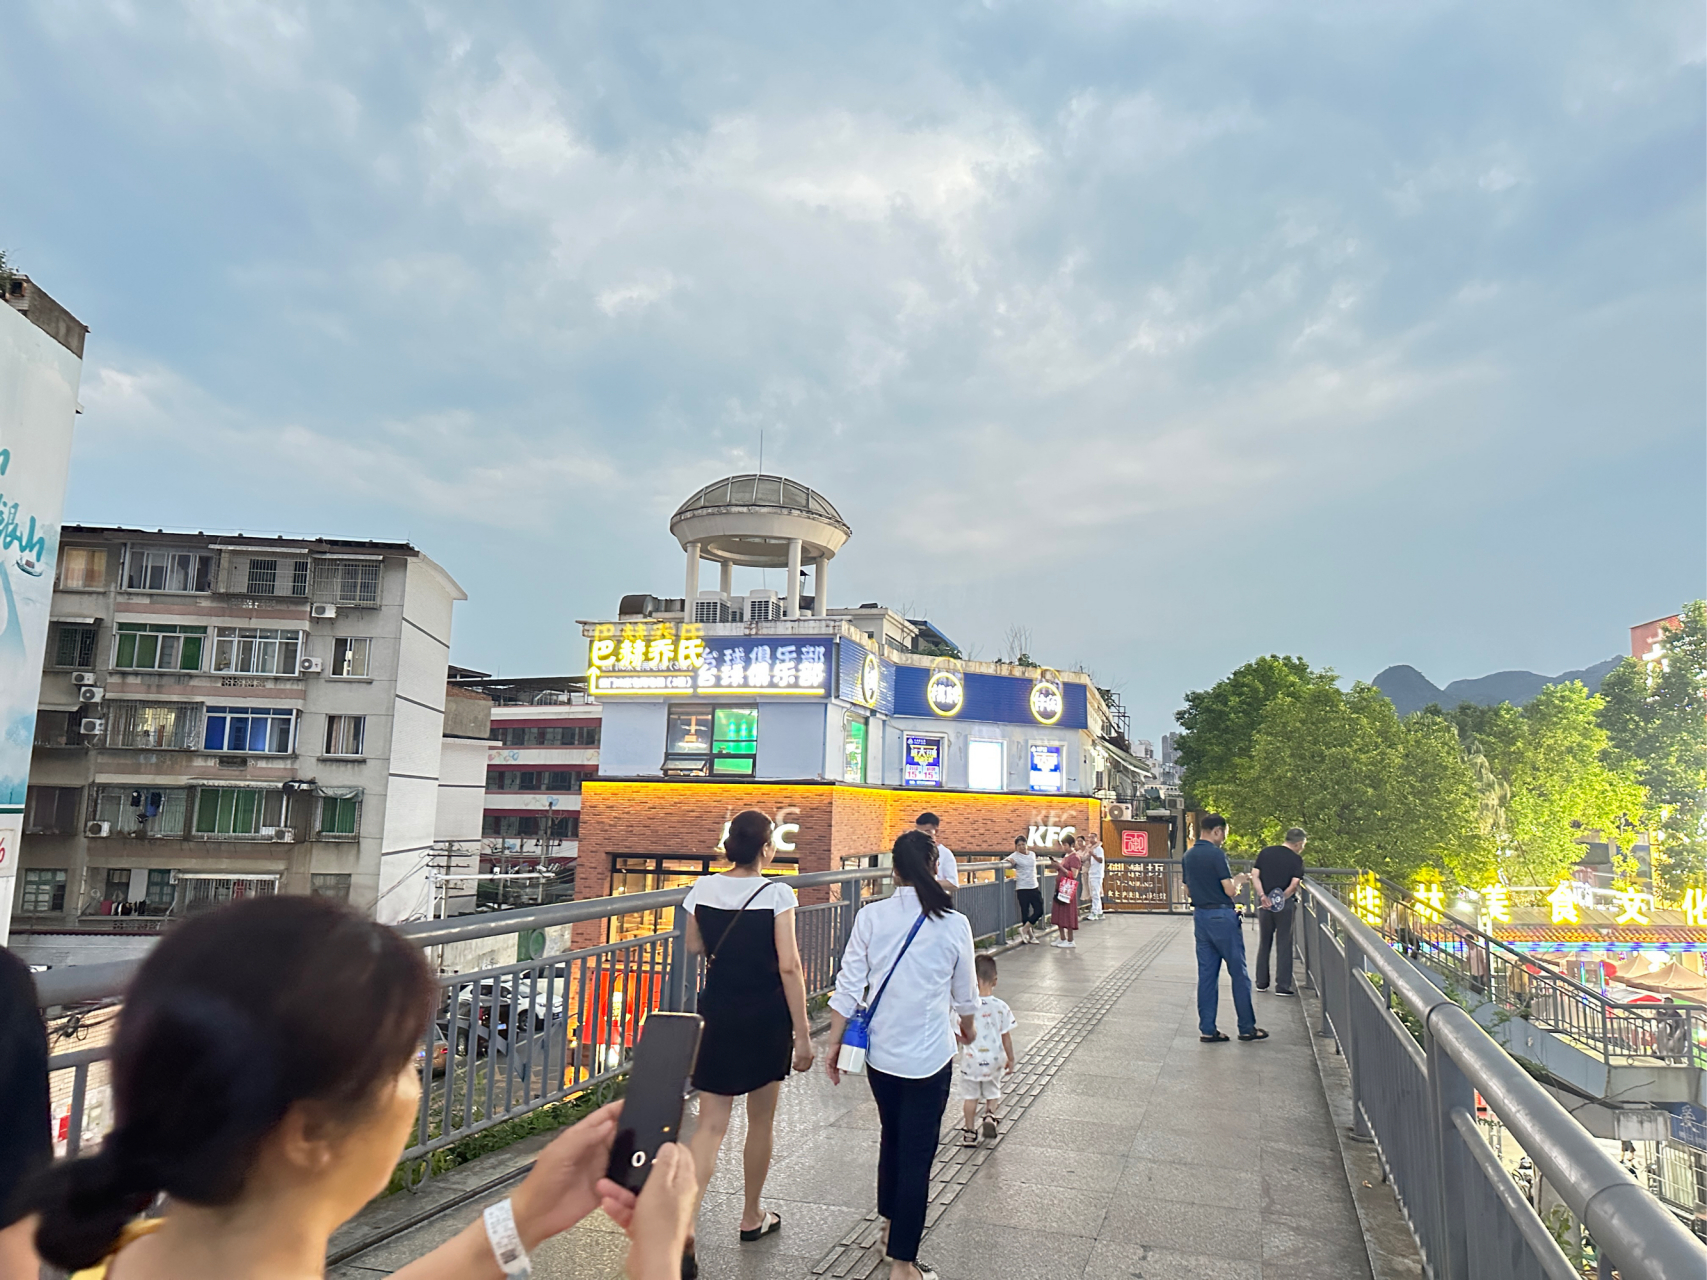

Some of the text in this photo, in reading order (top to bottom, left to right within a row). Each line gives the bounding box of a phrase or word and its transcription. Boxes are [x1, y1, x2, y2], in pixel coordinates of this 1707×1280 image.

[590, 638, 705, 668] 巴赫乔氏
[697, 661, 826, 687] 台球俱乐部
[1027, 826, 1076, 847] KFC
